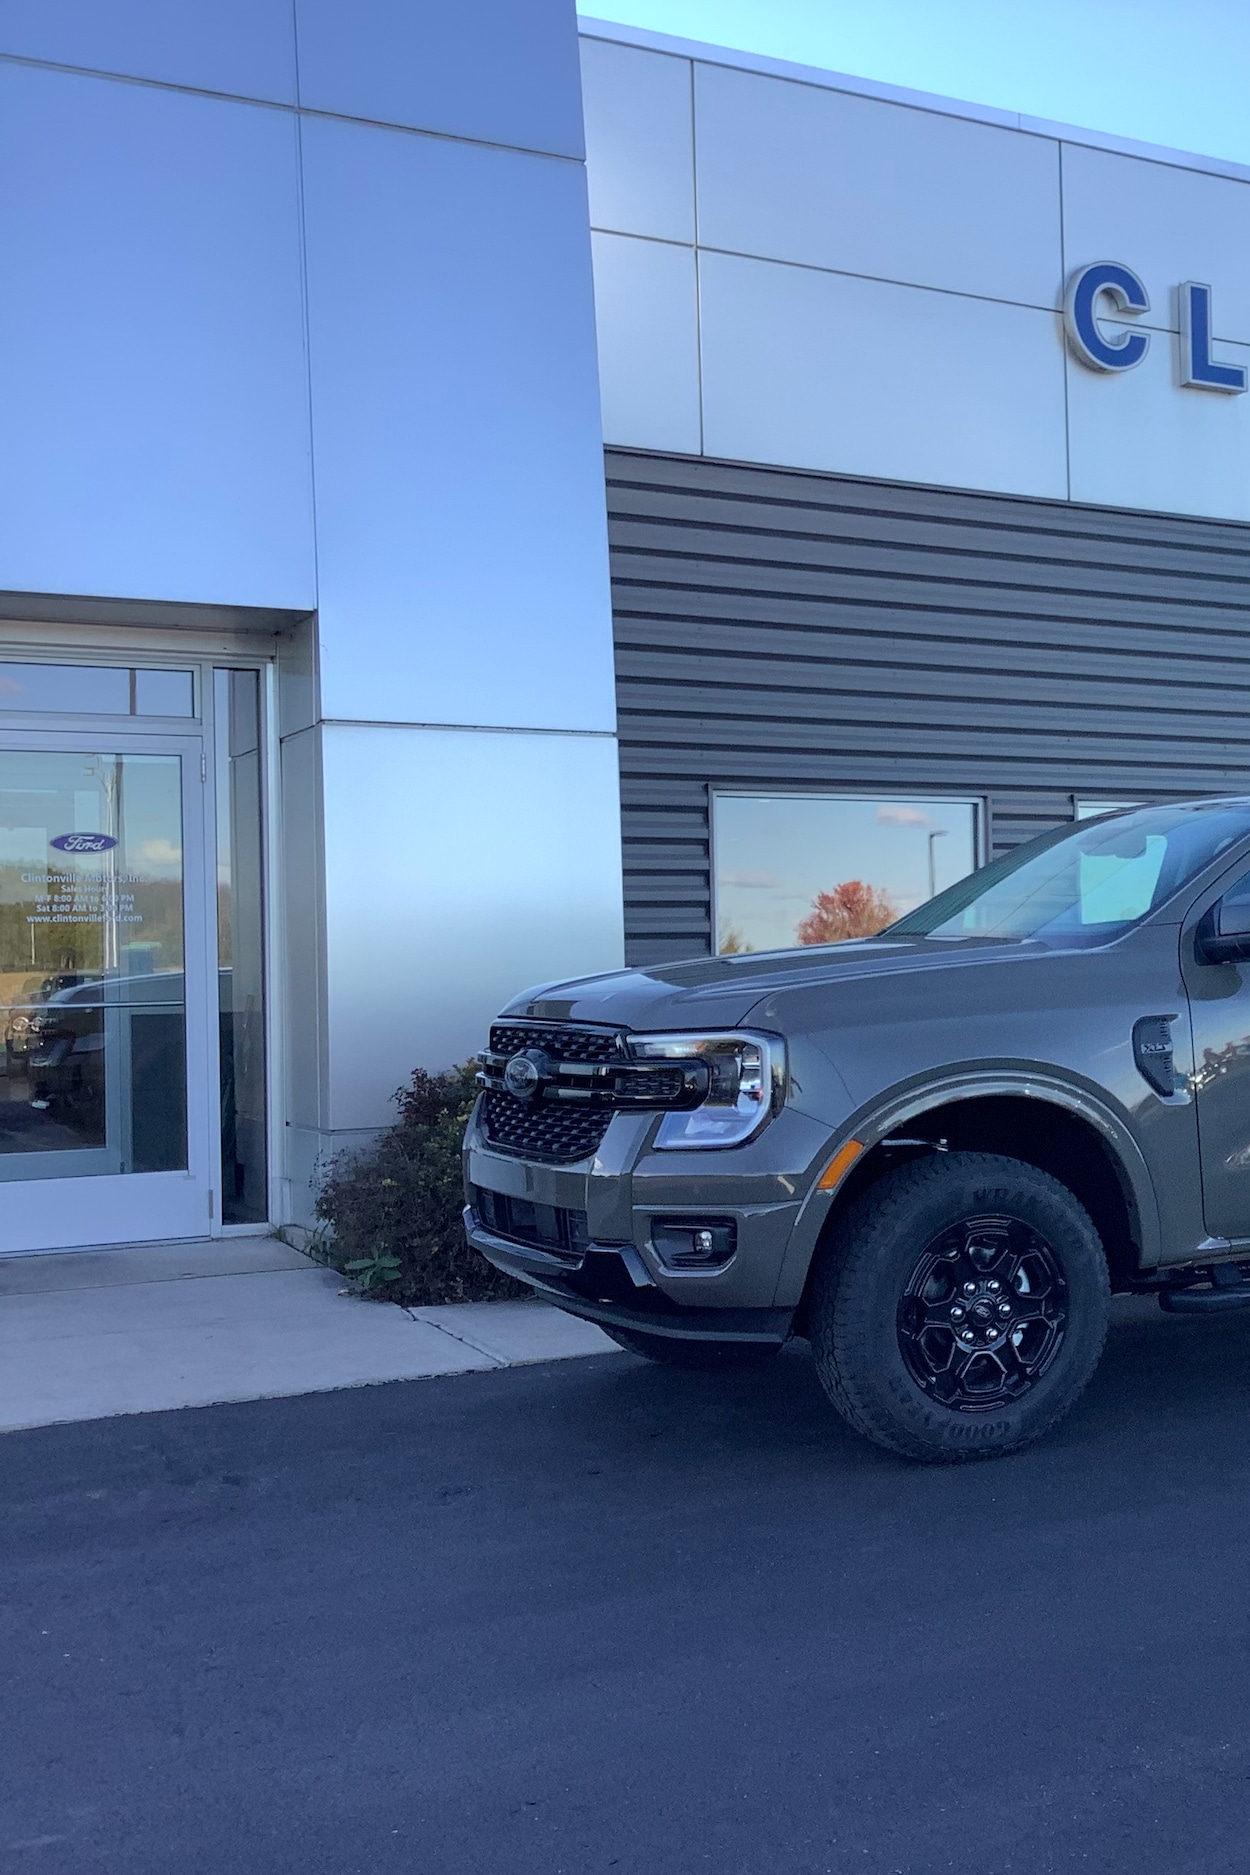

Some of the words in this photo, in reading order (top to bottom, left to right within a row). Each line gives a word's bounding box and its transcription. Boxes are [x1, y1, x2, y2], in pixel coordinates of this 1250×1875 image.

[64, 835, 105, 851] Ford
[21, 873, 81, 883] Clintonville
[61, 884, 82, 893] Sales
[53, 894, 72, 902] 8:00
[74, 894, 89, 902] AM
[90, 894, 99, 902] to
[120, 893, 135, 902] PM
[36, 903, 51, 912] Sat
[52, 903, 70, 912] 8:00
[72, 903, 87, 912] AM
[89, 903, 98, 912] to
[119, 903, 134, 912] PM
[26, 913, 143, 923] www.clintonvillefod.com
